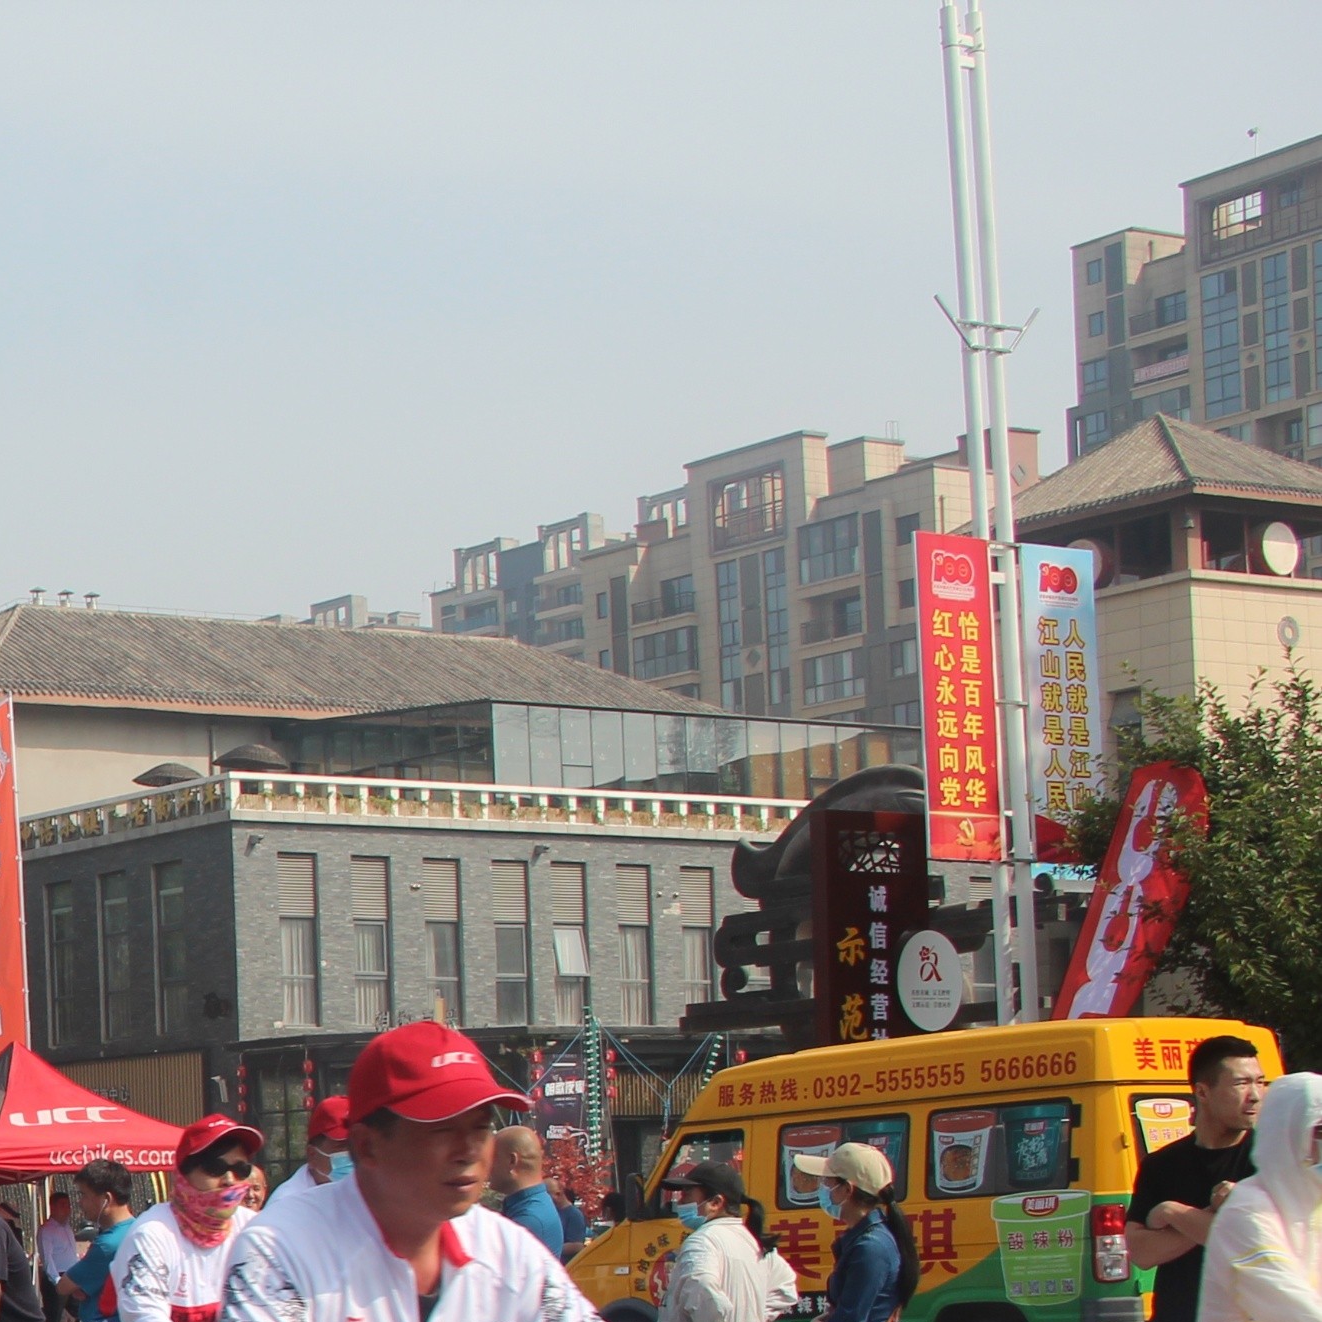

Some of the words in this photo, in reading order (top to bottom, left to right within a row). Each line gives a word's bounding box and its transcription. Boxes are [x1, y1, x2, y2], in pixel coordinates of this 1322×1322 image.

[932, 609, 961, 806] 红心永远向党
[958, 611, 987, 808] 恰是百年风华
[1038, 617, 1068, 811] 江山就是人民
[1064, 619, 1092, 811] 人民就是江山
[980, 1051, 1077, 1083] 5666666
[9, 1107, 126, 1127] UCC
[48, 1144, 177, 1167] uccbikes.com
[1024, 1196, 1057, 1214] 美丽琪
[770, 1208, 957, 1280] 美琪
[1007, 1228, 1075, 1252] 酸辣粉
